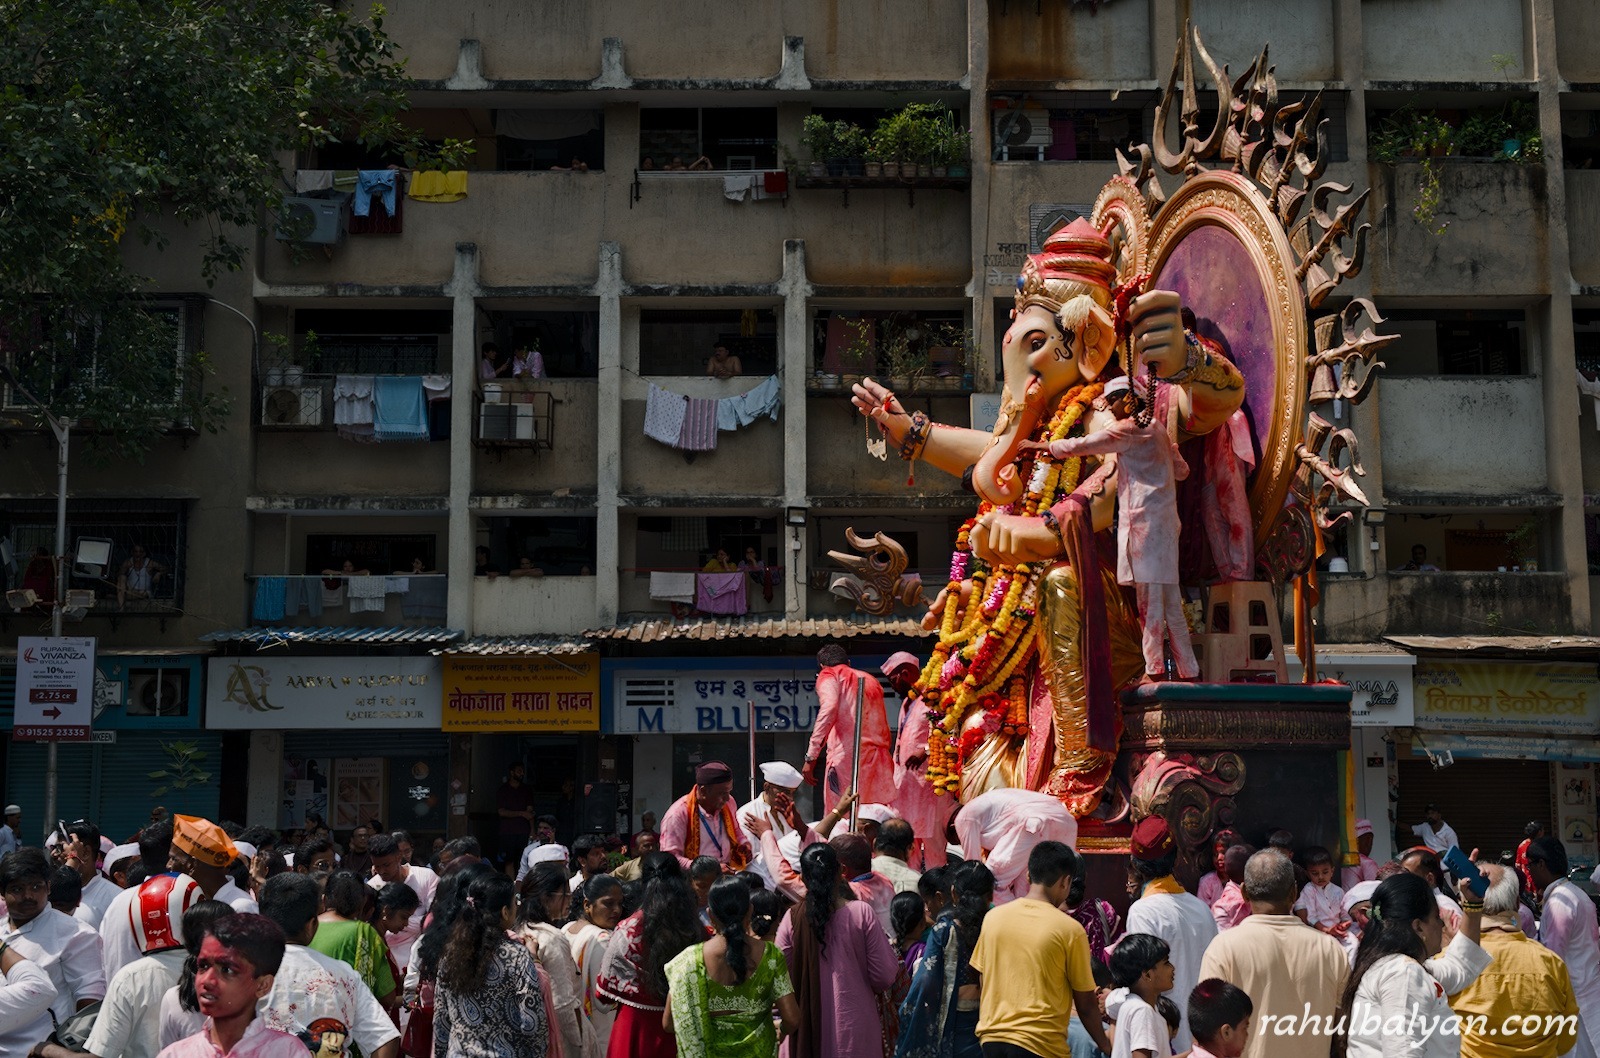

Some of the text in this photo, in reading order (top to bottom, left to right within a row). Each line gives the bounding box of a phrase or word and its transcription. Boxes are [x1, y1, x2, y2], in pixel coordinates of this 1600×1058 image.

[983, 254, 1026, 267] MHAD
[357, 675, 404, 689] GLOW
[407, 675, 429, 686] UP
[694, 679, 726, 698] एम
[732, 679, 746, 698] ३
[448, 687, 594, 711] नेकजात मराठा सदन
[1425, 687, 1588, 714] विलास डेकोरेटर्स
[637, 706, 665, 732] M
[695, 705, 820, 732] BLUESU
[92, 732, 113, 741] MKEEN
